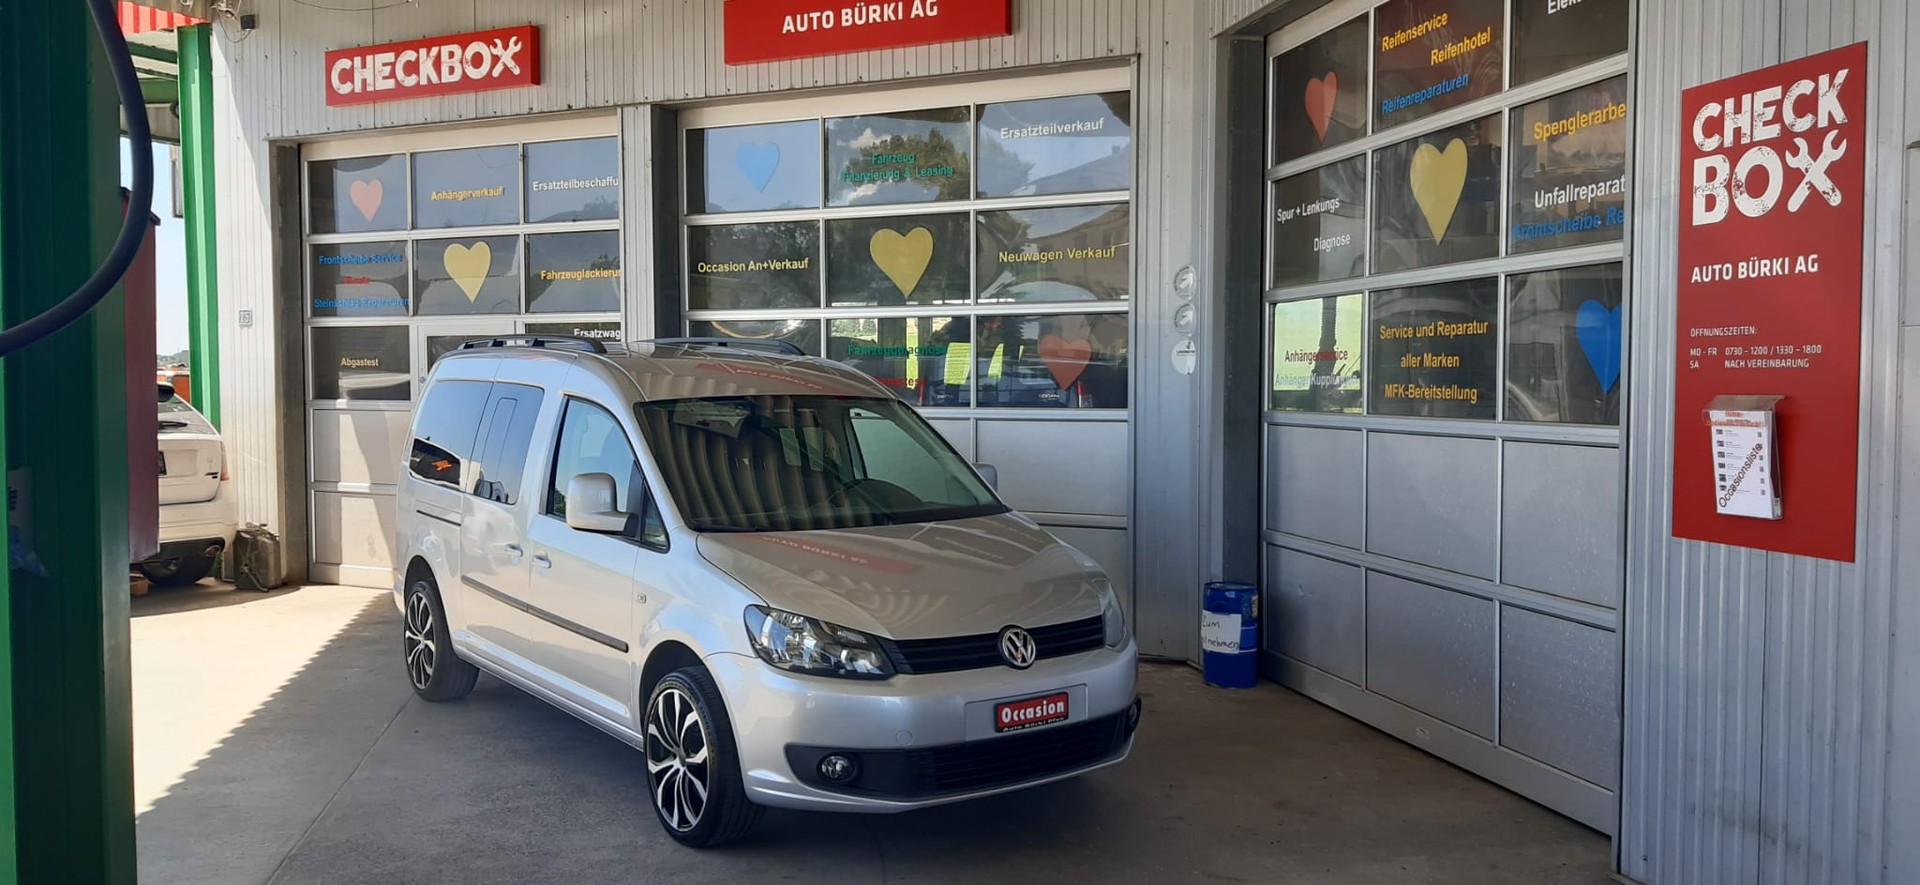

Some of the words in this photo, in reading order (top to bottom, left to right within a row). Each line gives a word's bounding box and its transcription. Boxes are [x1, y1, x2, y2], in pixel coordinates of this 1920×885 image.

[782, 11, 834, 33] AUTO
[841, 2, 903, 27] BÜRKI
[910, 0, 938, 19] AG
[1382, 11, 1448, 51] Reifenservice
[1431, 27, 1491, 65] Reifenhotel
[331, 36, 522, 94] CHECKBOX
[1382, 73, 1469, 114] Reifenreparaturen
[1693, 68, 1850, 151] CHECK
[1000, 118, 1104, 139] Ersatzteilverkauf
[1534, 102, 1627, 141] Spenglerarbe
[872, 153, 915, 164] Fahrzeug
[843, 169, 900, 182] Finanzierung
[904, 167, 911, 179] &
[915, 166, 953, 177] Leasing
[1692, 130, 1847, 226] BOX
[431, 186, 504, 201] Anhängerverkauf
[532, 177, 619, 192] Ersatzteilbeschaffu
[1535, 175, 1625, 208] Unfallreparat
[1277, 208, 1294, 224] Spur
[1295, 205, 1301, 216] +
[1302, 197, 1340, 217] Lenkungs
[1314, 233, 1350, 252] Diagnose
[999, 249, 1063, 263] Neuwagen
[1067, 246, 1116, 259] Verkauf
[697, 261, 746, 273] Occasion
[748, 257, 809, 271] An+Verkauf
[1691, 263, 1732, 283] AUTO
[1738, 257, 1789, 279] BÜRKI
[1795, 254, 1818, 273] AG
[574, 328, 621, 340] Ersatzwag
[1380, 324, 1414, 339] Service
[1416, 322, 1435, 337] und
[1437, 320, 1488, 340] Reparatur
[1690, 326, 1758, 337] ÖFFNUNGSZEITEN:
[1401, 353, 1421, 368] aller
[1423, 352, 1460, 368] Marken
[1690, 347, 1701, 356] MO
[1708, 347, 1717, 356] FR
[1725, 346, 1742, 356] 0730
[1751, 345, 1768, 355] 1200
[1776, 345, 1794, 354] 1330
[1803, 344, 1822, 354] 1800
[341, 357, 379, 368] Abgastest
[1690, 360, 1699, 369] SA
[1725, 360, 1745, 369] NACH
[1747, 358, 1810, 368] VEREINBARUNG
[1385, 384, 1478, 404] MFK-Bereitstellung
[1718, 442, 1763, 508] Occasionsliste
[1002, 700, 1064, 723] Occasion
